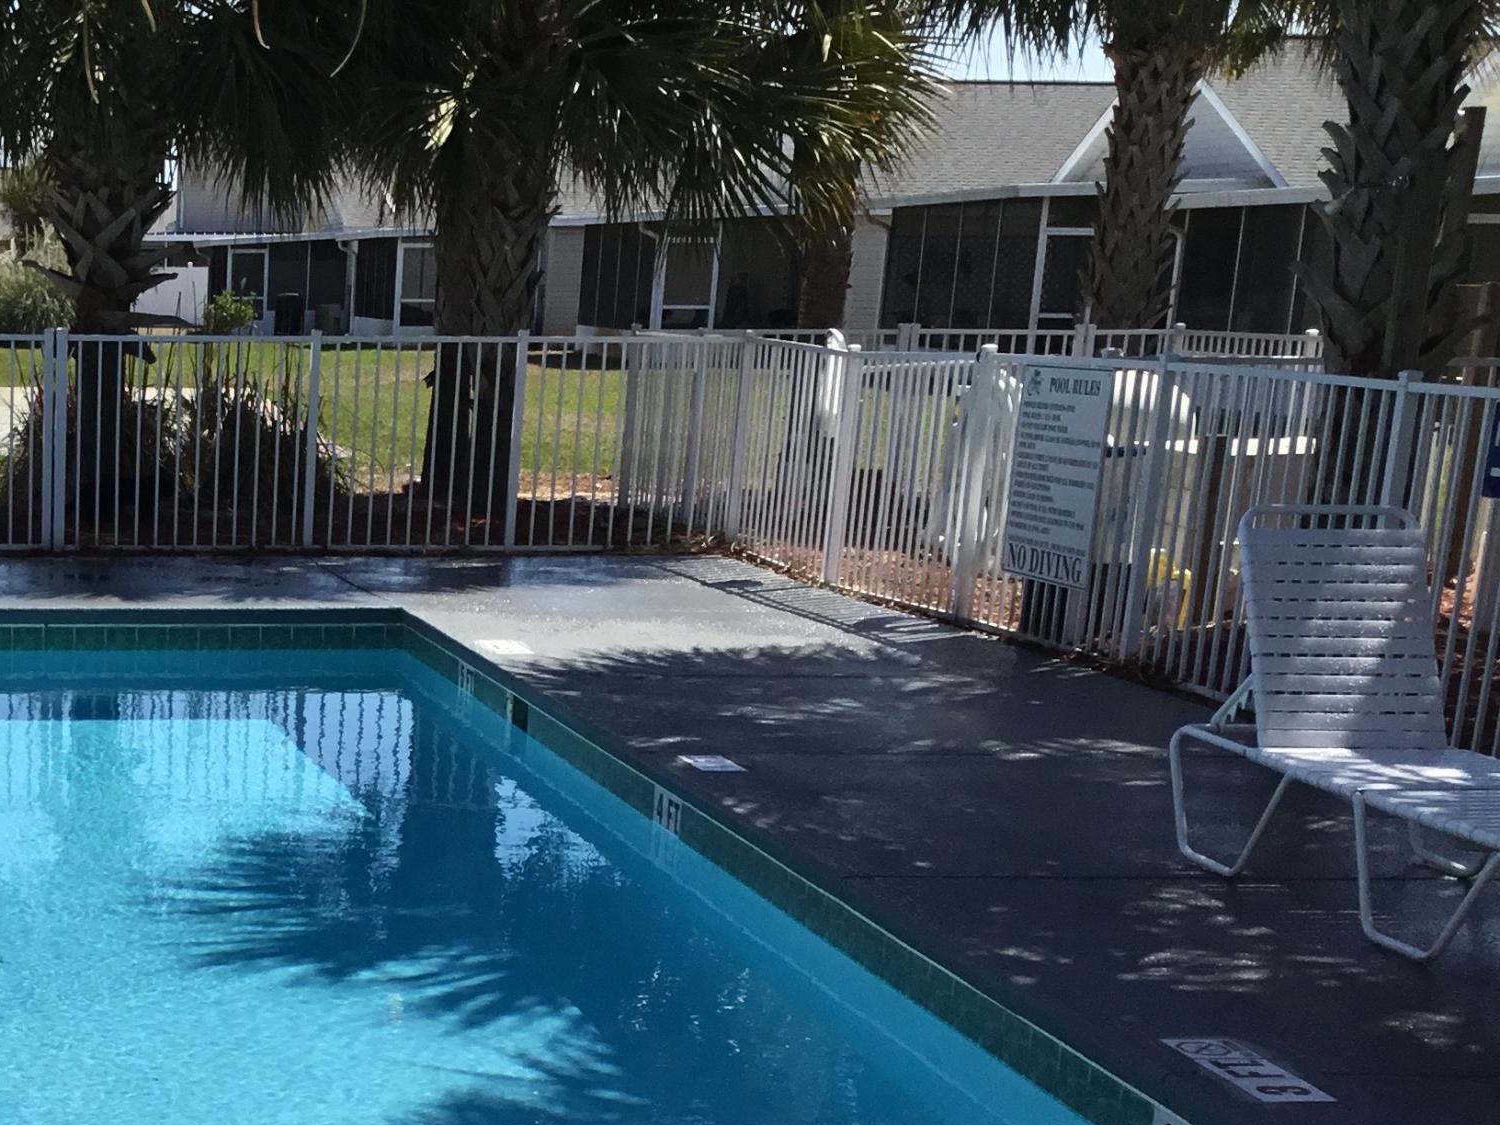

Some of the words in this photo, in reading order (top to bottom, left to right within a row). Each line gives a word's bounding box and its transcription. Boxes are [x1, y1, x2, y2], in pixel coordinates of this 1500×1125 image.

[1049, 377, 1071, 395] POOL
[1072, 378, 1102, 397] RULES
[1007, 542, 1027, 571] NO
[1028, 547, 1082, 584] DIVING
[1255, 1085, 1312, 1096] 3
